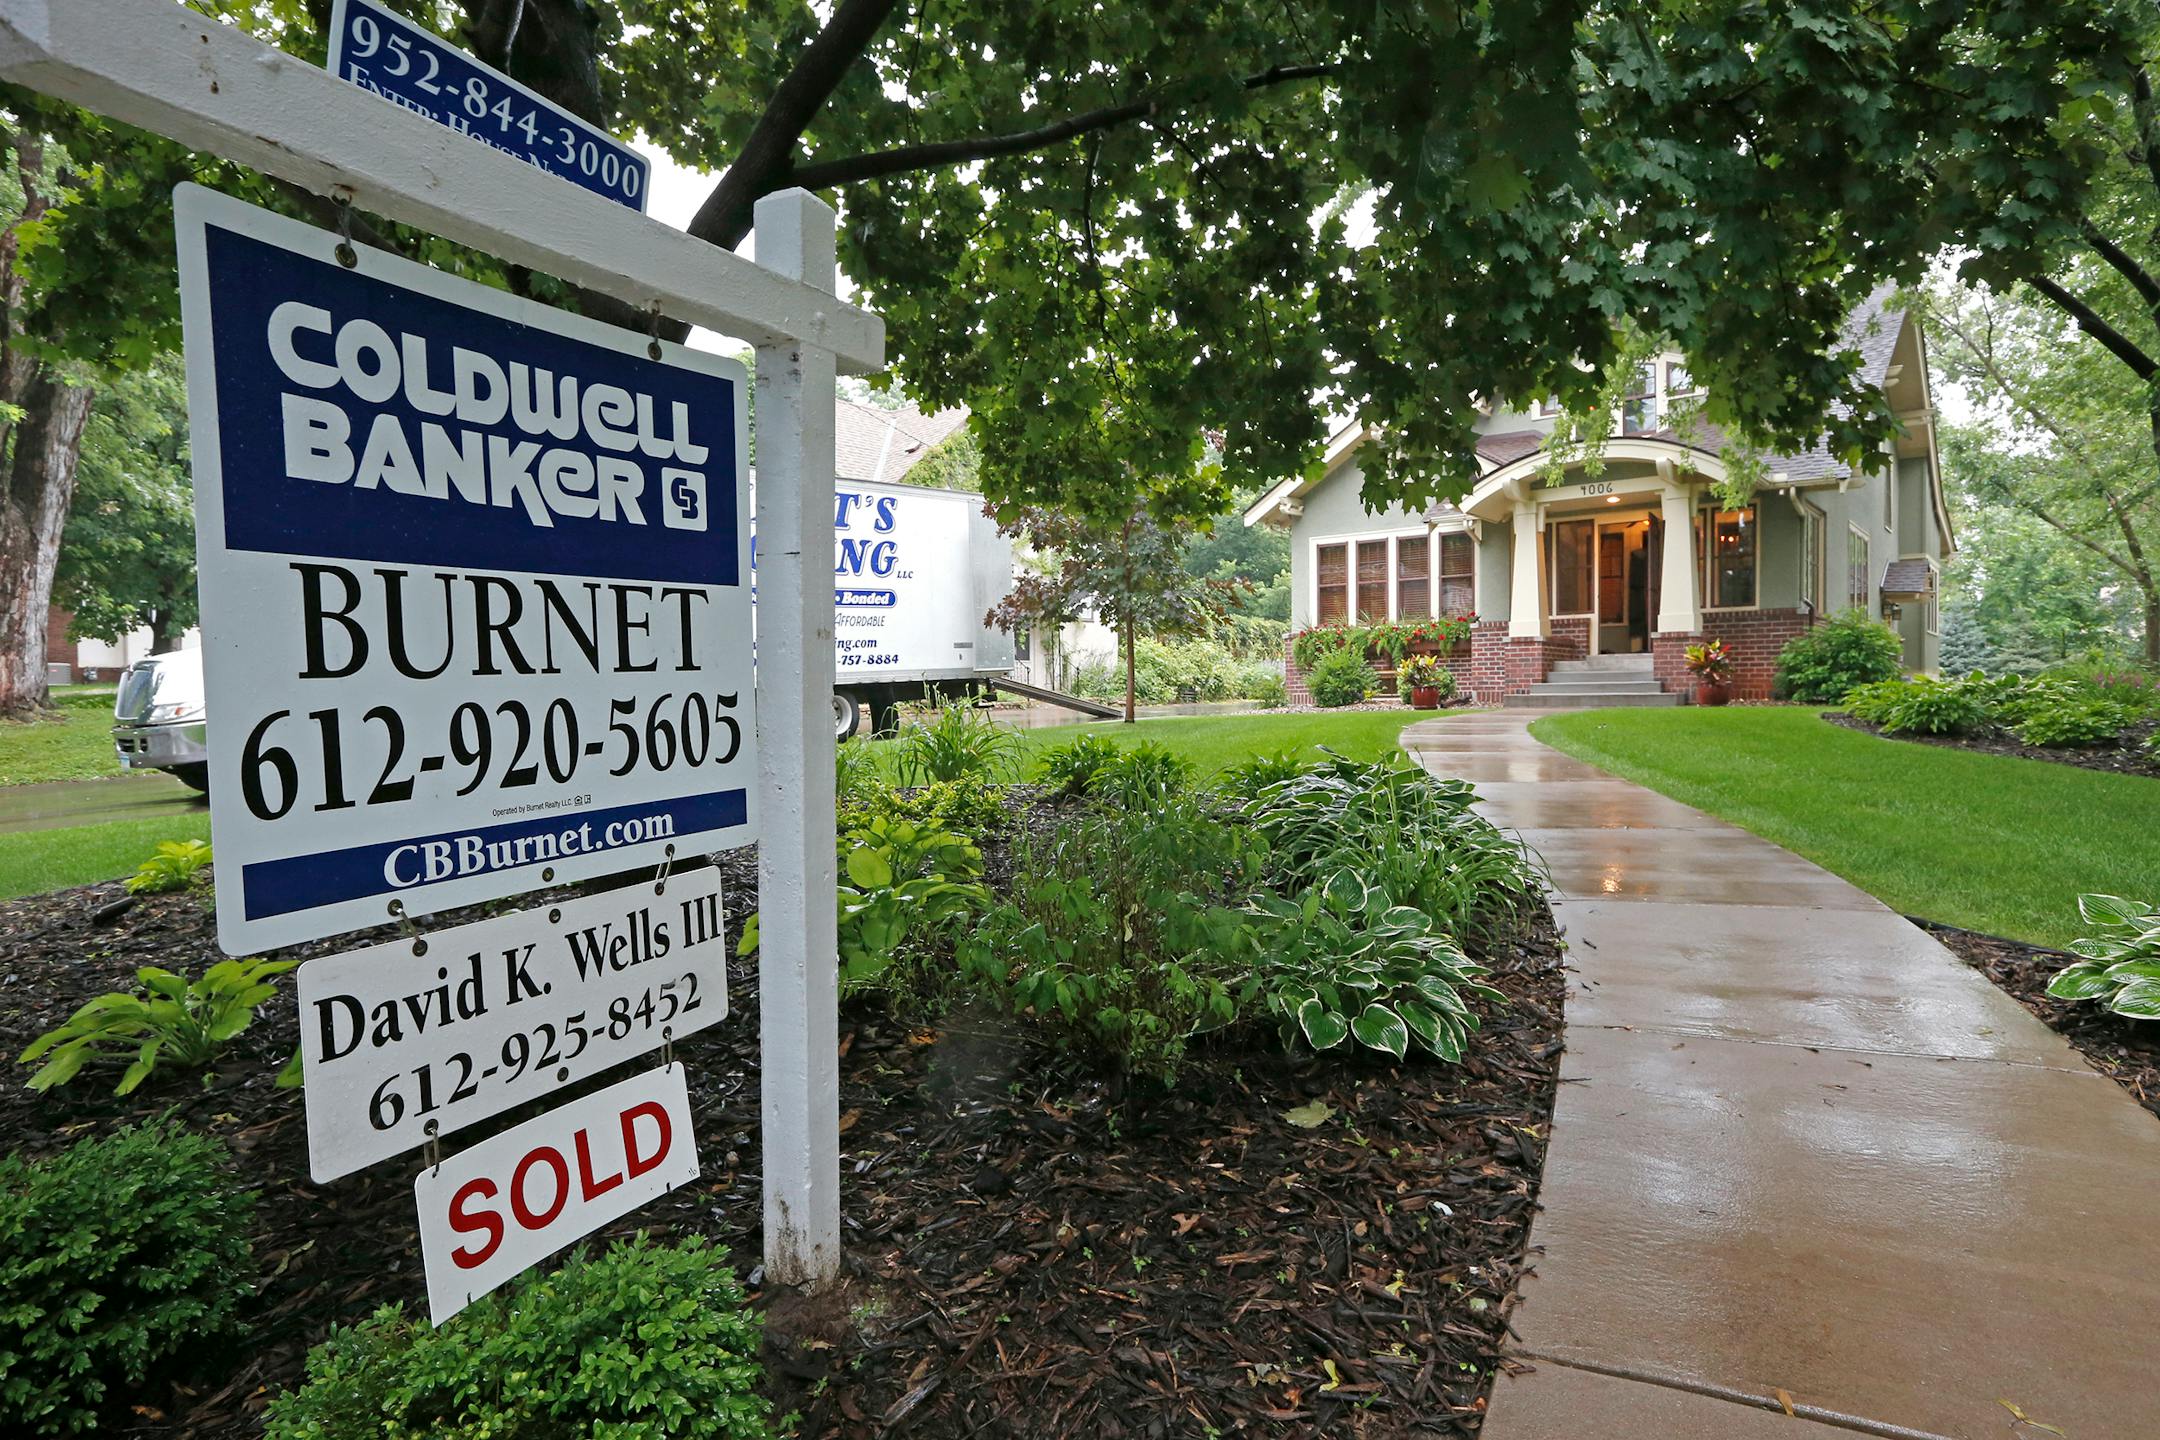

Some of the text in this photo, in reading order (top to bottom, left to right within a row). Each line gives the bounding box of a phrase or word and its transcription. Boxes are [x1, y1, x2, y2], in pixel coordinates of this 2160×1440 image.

[351, 16, 640, 198] 952-844-3000
[267, 301, 709, 465] COLDWELL
[281, 392, 647, 528] BANKER
[1580, 483, 1613, 496] 4006
[289, 562, 709, 680] BURNET
[834, 539, 914, 579] NG LLC
[841, 592, 890, 605] Bonded
[241, 691, 741, 821] 612-920-5605
[492, 806, 518, 817] Operated
[526, 803, 544, 812] Burnet
[545, 801, 560, 809] Realty
[384, 811, 675, 888] CBBurnet.com
[313, 893, 721, 1064] David K. Wells III
[369, 972, 702, 1131] 612-925-8452
[448, 1101, 672, 1269] SOLD
